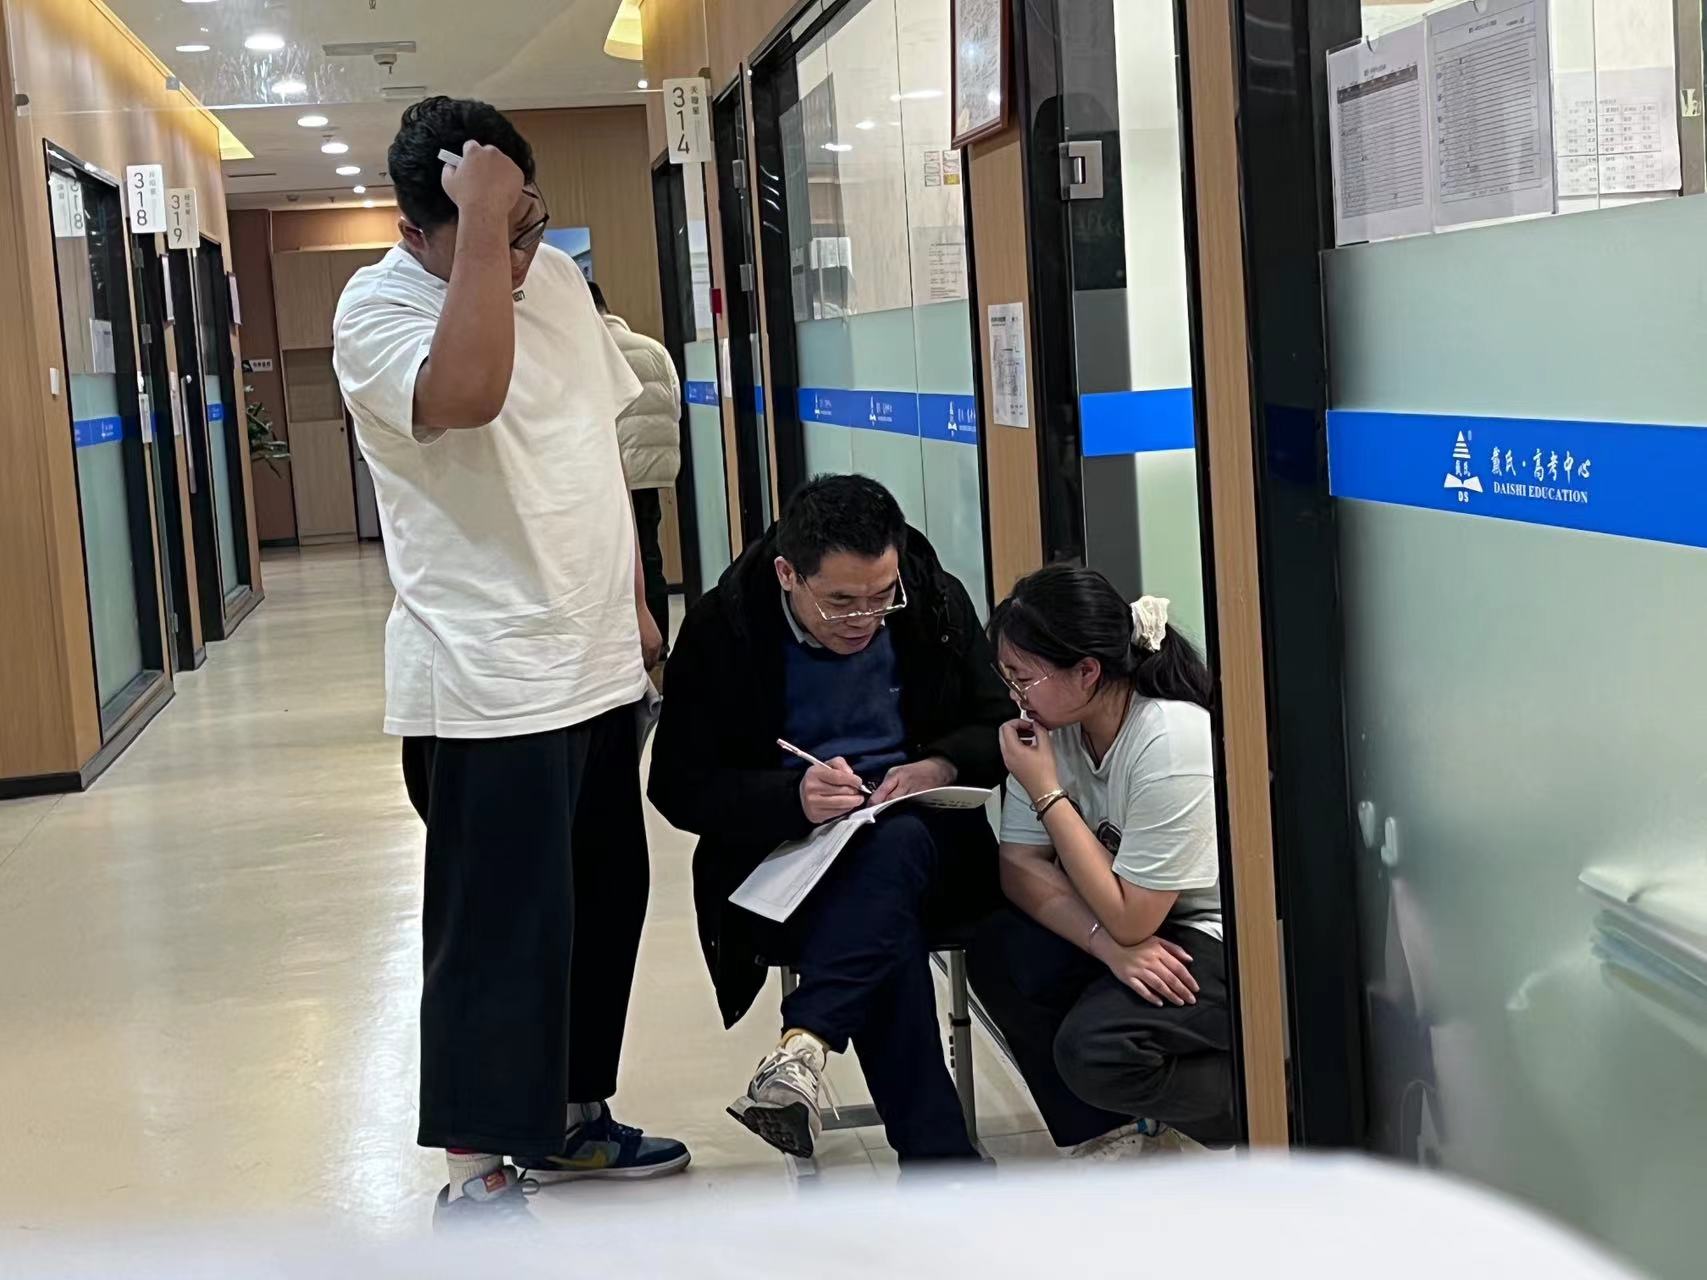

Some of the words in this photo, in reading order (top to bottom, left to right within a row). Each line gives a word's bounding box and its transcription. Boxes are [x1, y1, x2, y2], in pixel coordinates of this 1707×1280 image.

[673, 86, 690, 154] 314
[134, 172, 147, 226] 318
[171, 194, 182, 243] 319
[1458, 491, 1469, 503] DS
[1493, 481, 1527, 497] DAISHI
[1529, 485, 1588, 503] EDUCATION
